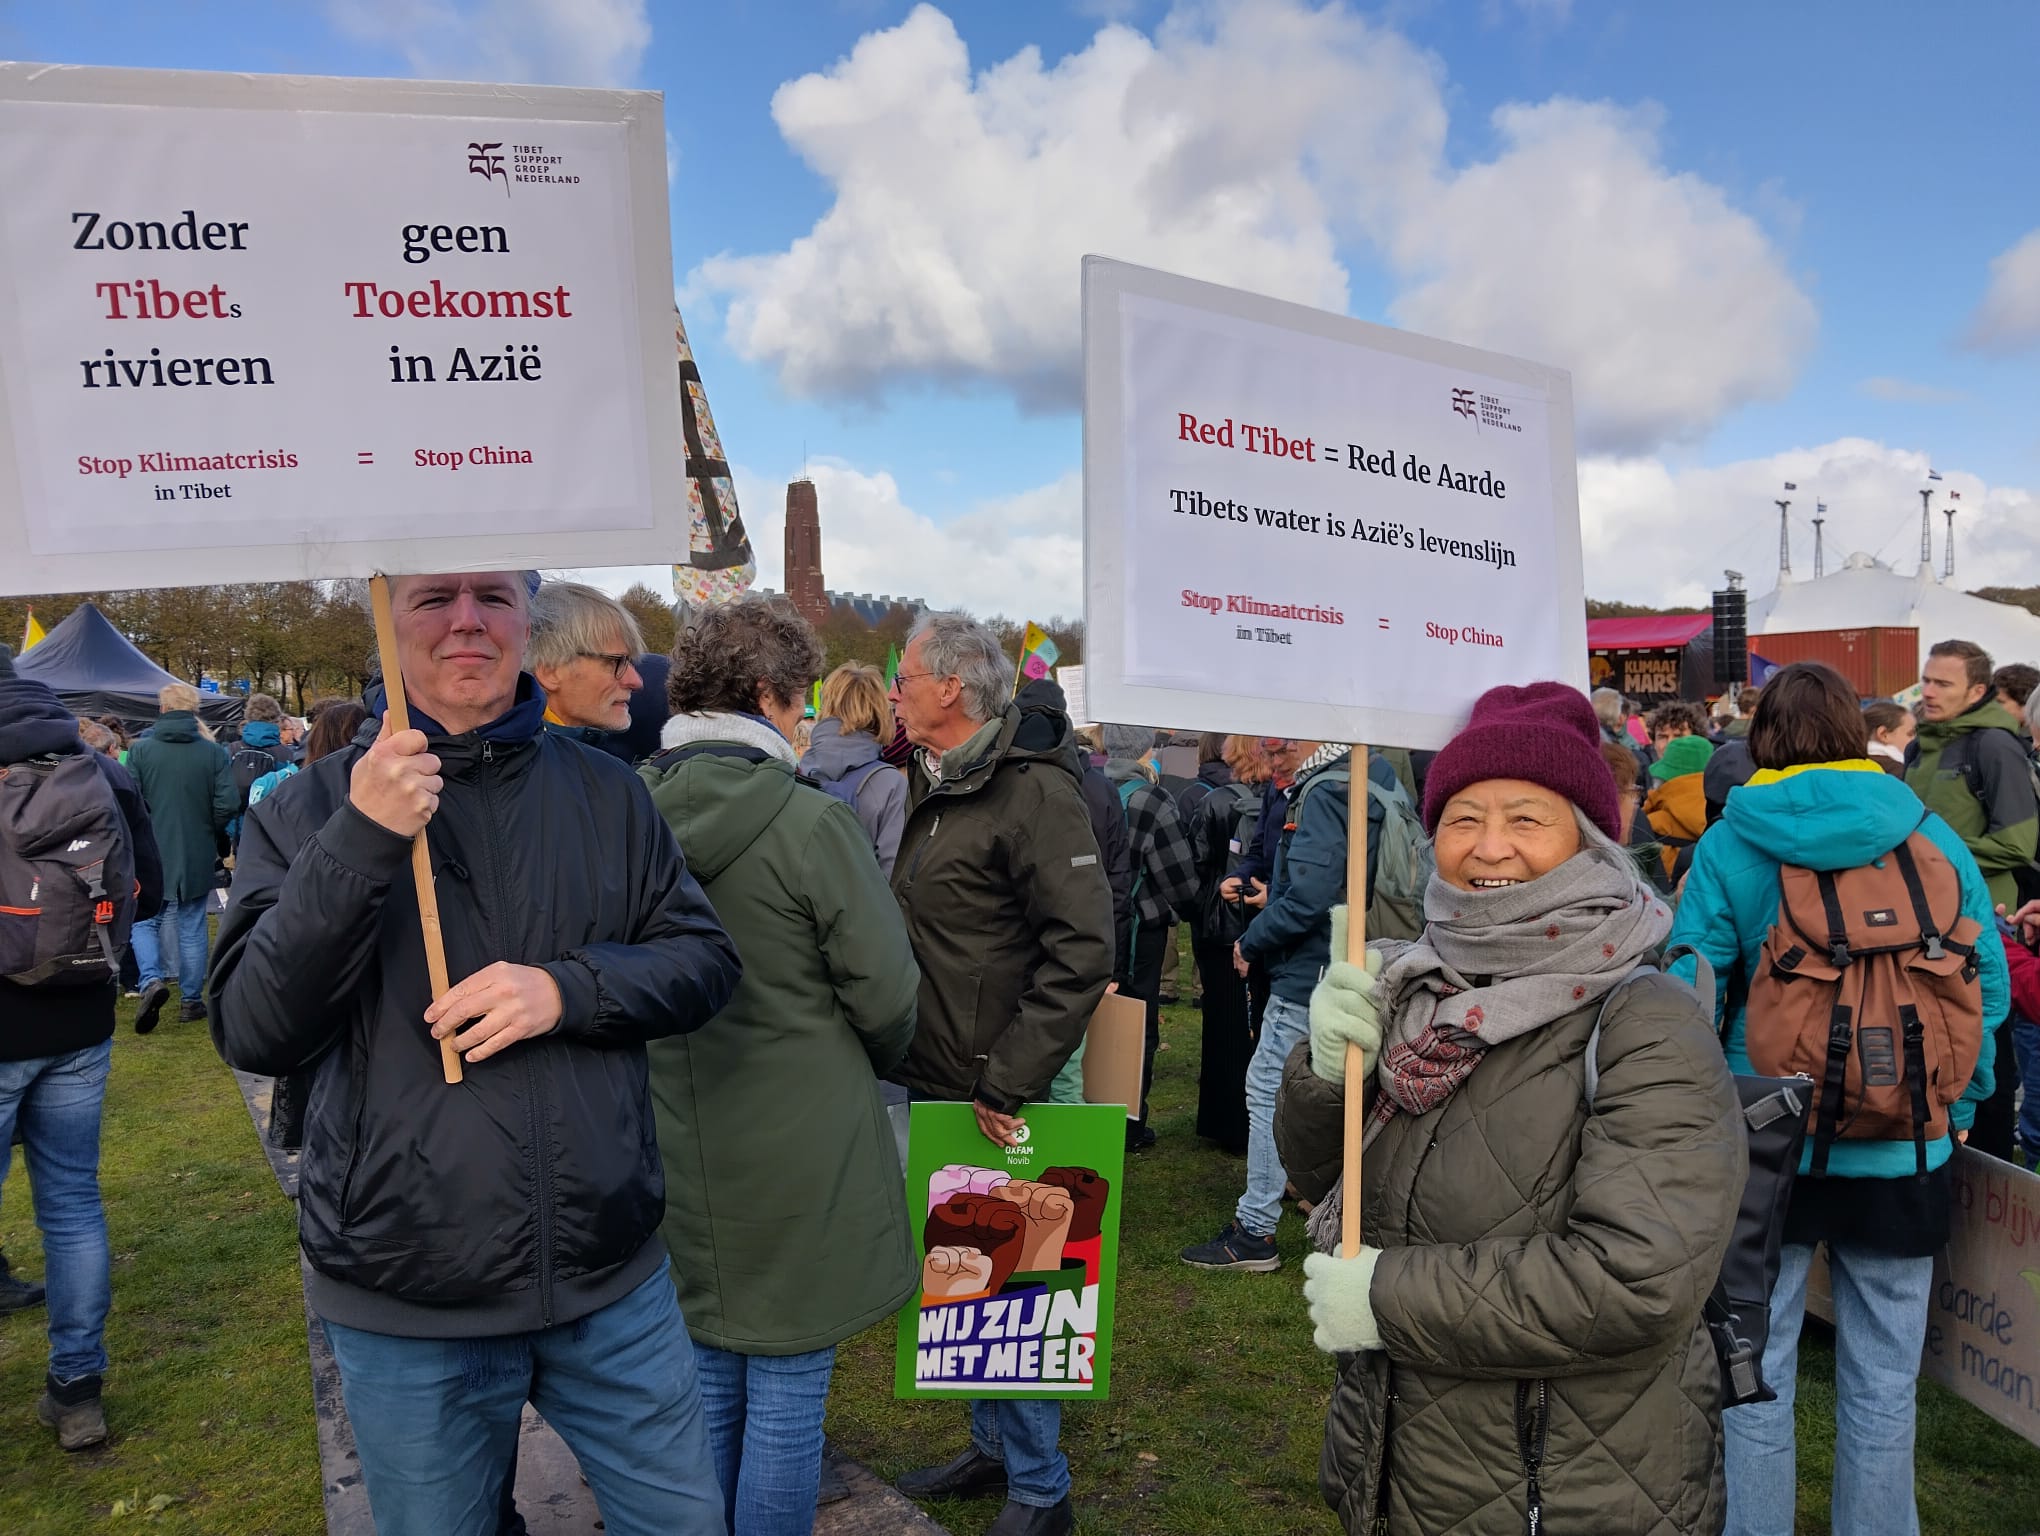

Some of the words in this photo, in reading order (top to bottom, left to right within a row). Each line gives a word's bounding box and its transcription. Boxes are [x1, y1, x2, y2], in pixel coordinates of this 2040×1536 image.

[512, 146, 543, 154] TIBET
[514, 155, 562, 164] SUPPORT
[515, 165, 549, 173] GROEP
[516, 175, 580, 183] NEDERLAND
[72, 210, 249, 250] Zonder
[402, 225, 510, 264] geen
[96, 279, 242, 319] Tibets
[345, 280, 572, 318] Toekomst
[80, 348, 275, 388] rivieren
[389, 345, 436, 382] in
[446, 345, 541, 381] Azië
[1480, 395, 1499, 404] TIBET
[1481, 402, 1510, 415] SUPPORT
[1481, 409, 1503, 420] GROEP
[1482, 417, 1522, 432] NEDERLAND
[78, 456, 132, 478] Stop
[137, 449, 298, 472] Klimaatcrisis
[358, 452, 374, 464] =
[415, 449, 464, 470] Stop
[469, 446, 533, 464] China
[1178, 413, 1234, 448] Red
[1241, 424, 1316, 462] Tibet
[1325, 448, 1338, 462] =
[1347, 444, 1397, 477] Red
[1403, 454, 1431, 484] de
[1437, 464, 1505, 499] Aarde
[154, 485, 176, 500] in
[179, 483, 232, 499] Tibet
[1170, 490, 1248, 522] Tibets
[1254, 508, 1320, 533] water
[1326, 512, 1345, 537] is
[1351, 519, 1414, 548] Azië’s
[1419, 528, 1516, 570] levenslijn
[1181, 590, 1223, 615] Stop
[1226, 595, 1344, 624] Klimaatcrisis
[1378, 618, 1390, 629] =
[1426, 622, 1458, 645] Stop
[1462, 627, 1503, 647] China
[1236, 625, 1253, 640] in
[1255, 628, 1293, 644] Tibet
[1624, 660, 1677, 673] KLIMAAT
[1624, 673, 1677, 693] MARS
[1005, 1145, 1034, 1155] OXFAM
[1007, 1156, 1030, 1165] Novib
[918, 1305, 975, 1343] WIJ
[978, 1285, 1099, 1339] ZIJN
[1939, 1281, 2012, 1345] aarde
[916, 1347, 982, 1379] MET
[983, 1337, 1096, 1379] MEER
